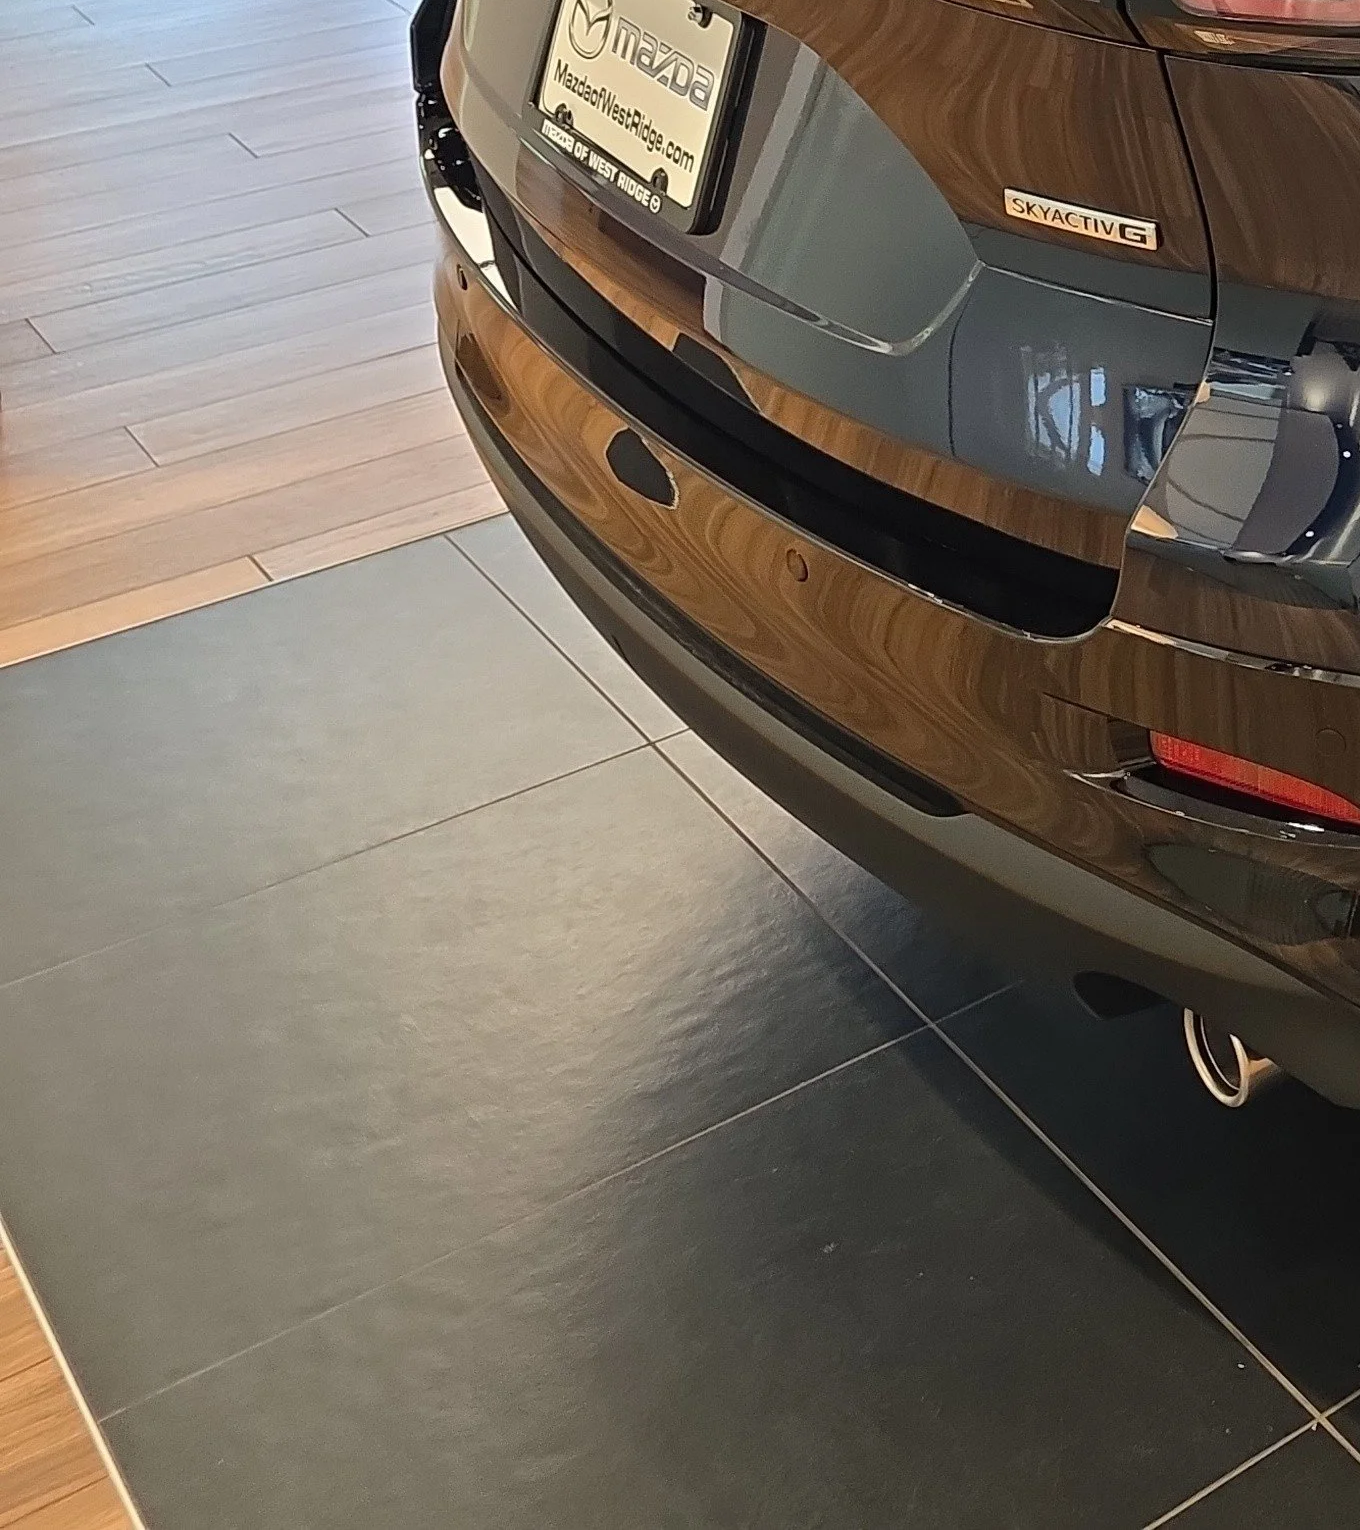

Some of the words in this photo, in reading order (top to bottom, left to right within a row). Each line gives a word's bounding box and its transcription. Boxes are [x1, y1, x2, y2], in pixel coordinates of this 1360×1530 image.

[552, 57, 696, 175] MazdaofWestRidge.com
[573, 141, 590, 161] OF
[588, 150, 619, 183] WEST
[616, 171, 652, 207] RIDGE
